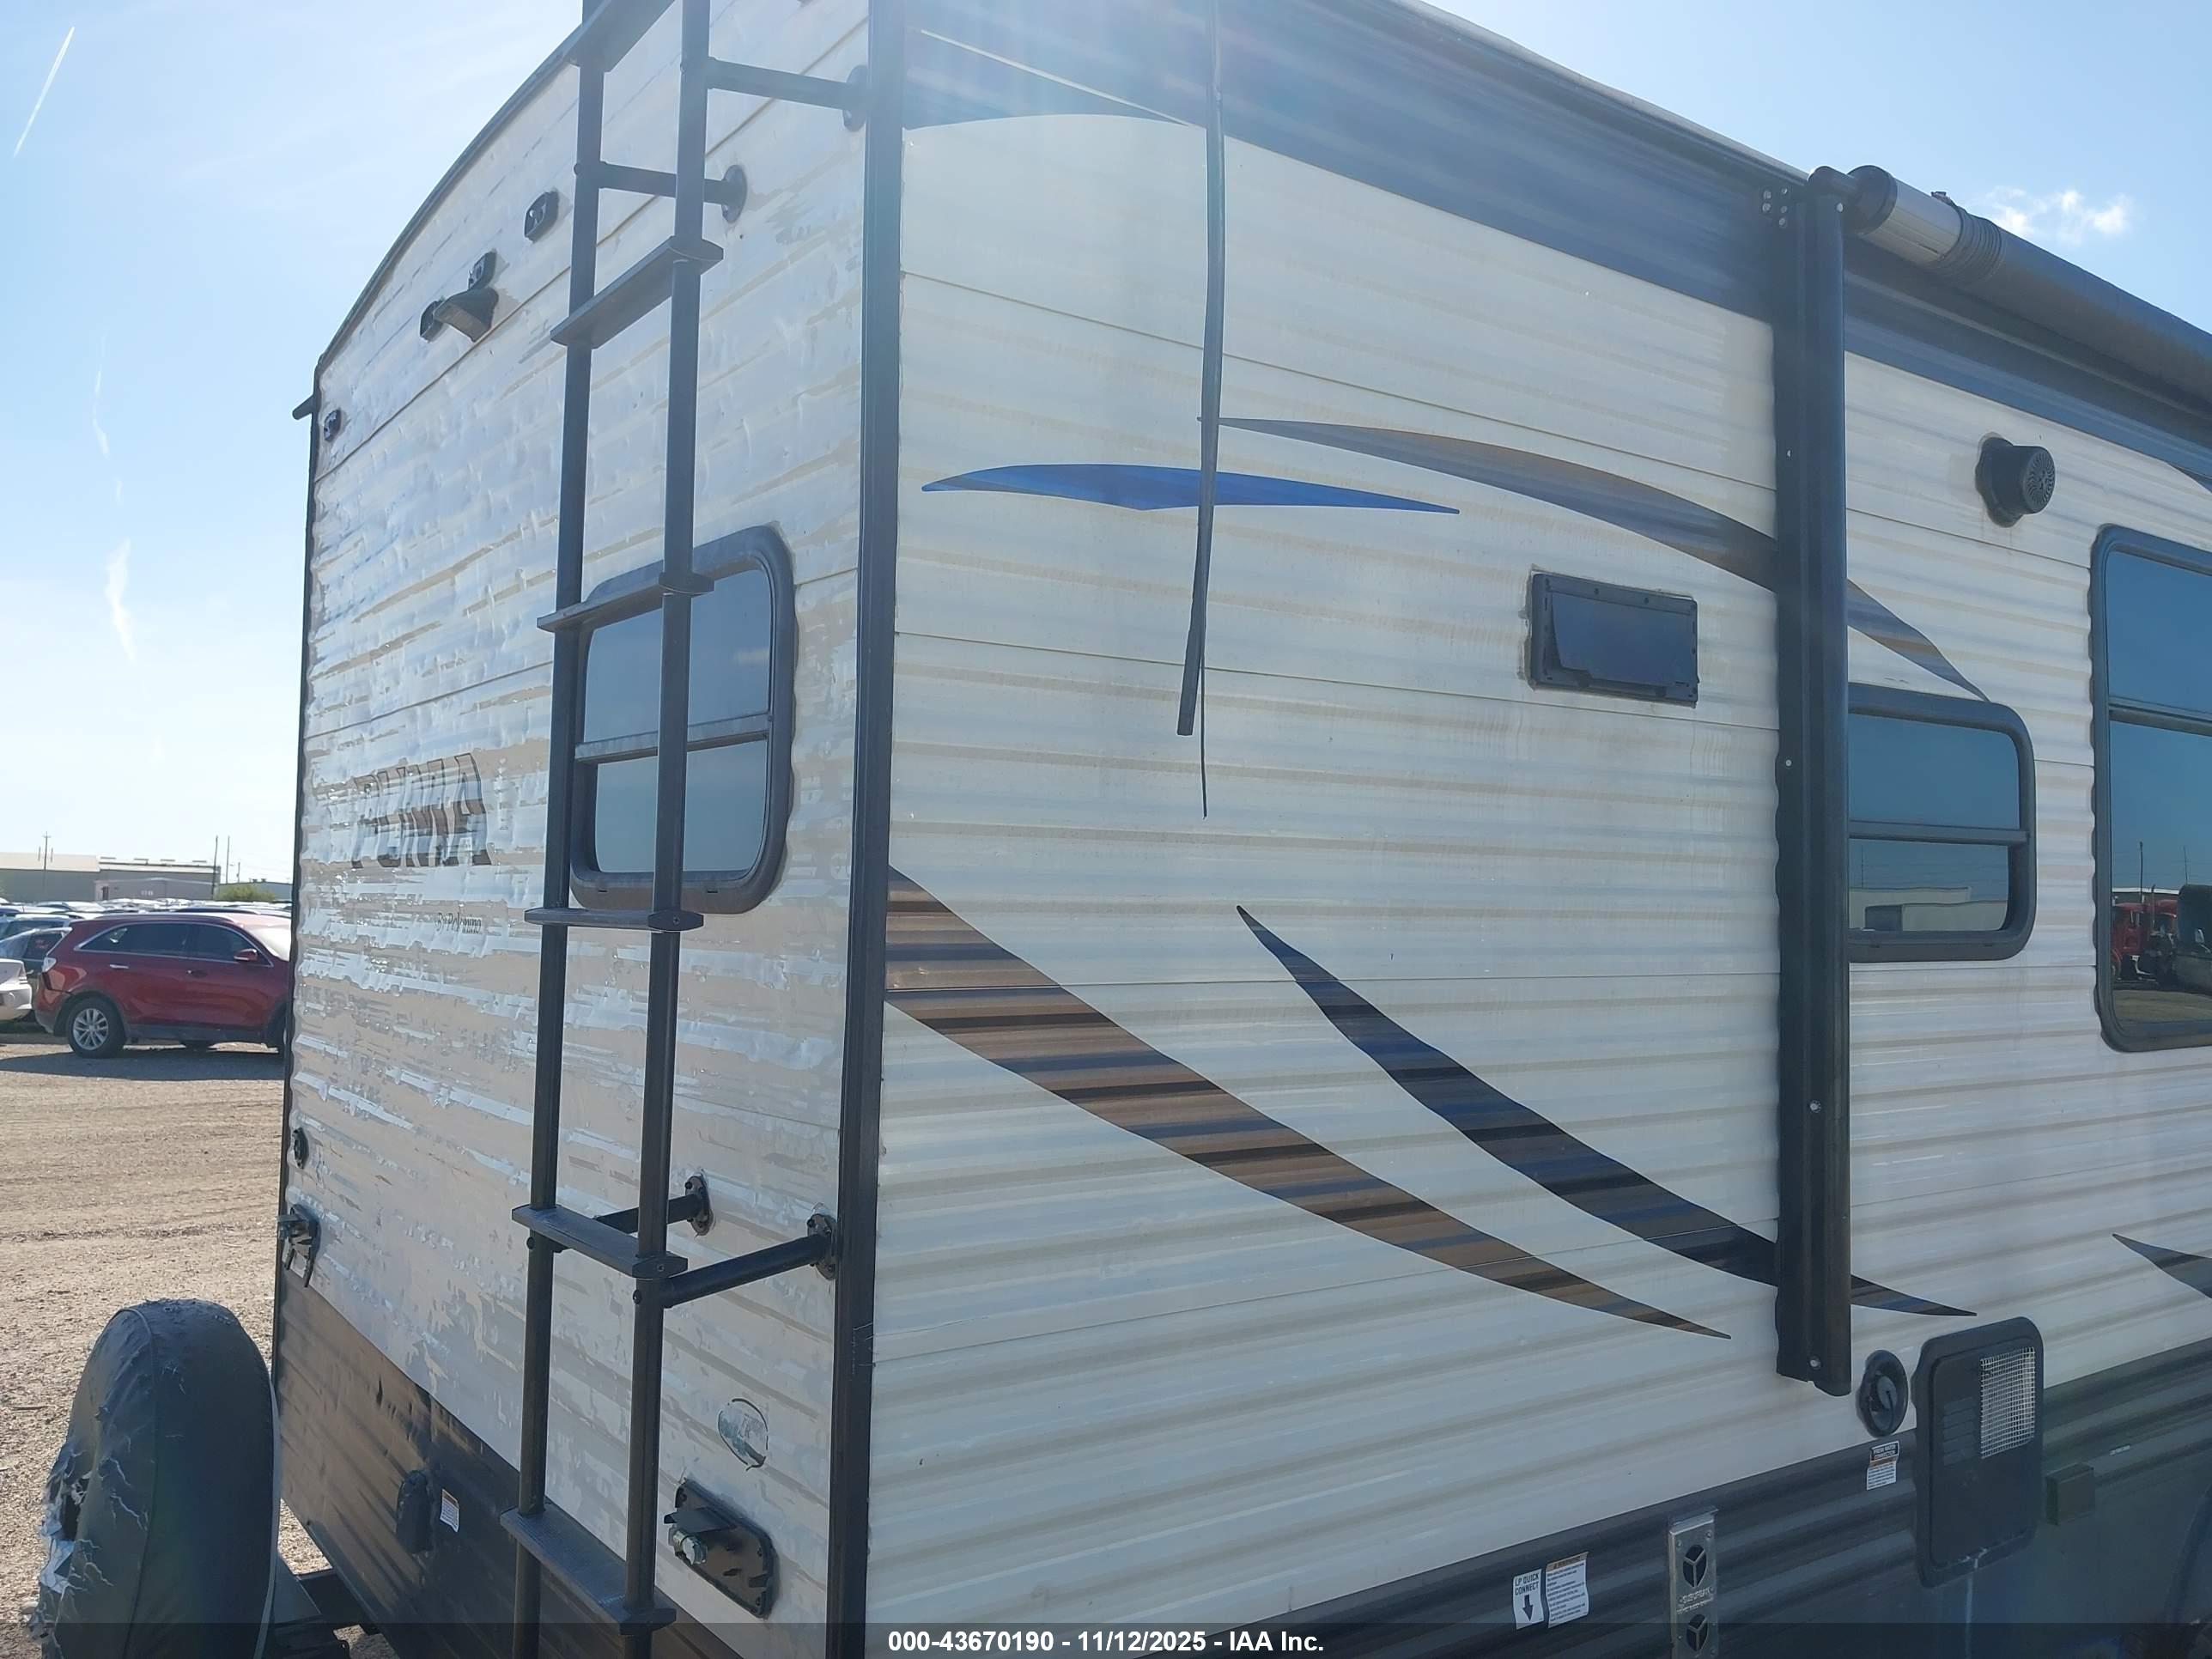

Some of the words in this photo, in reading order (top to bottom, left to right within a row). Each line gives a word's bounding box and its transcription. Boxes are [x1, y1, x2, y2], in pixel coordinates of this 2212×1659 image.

[351, 752, 492, 868] PUMA
[1515, 1577, 1522, 1587] LP
[1522, 1573, 1540, 1583] QUICK
[1515, 1582, 1540, 1595] CONNECT
